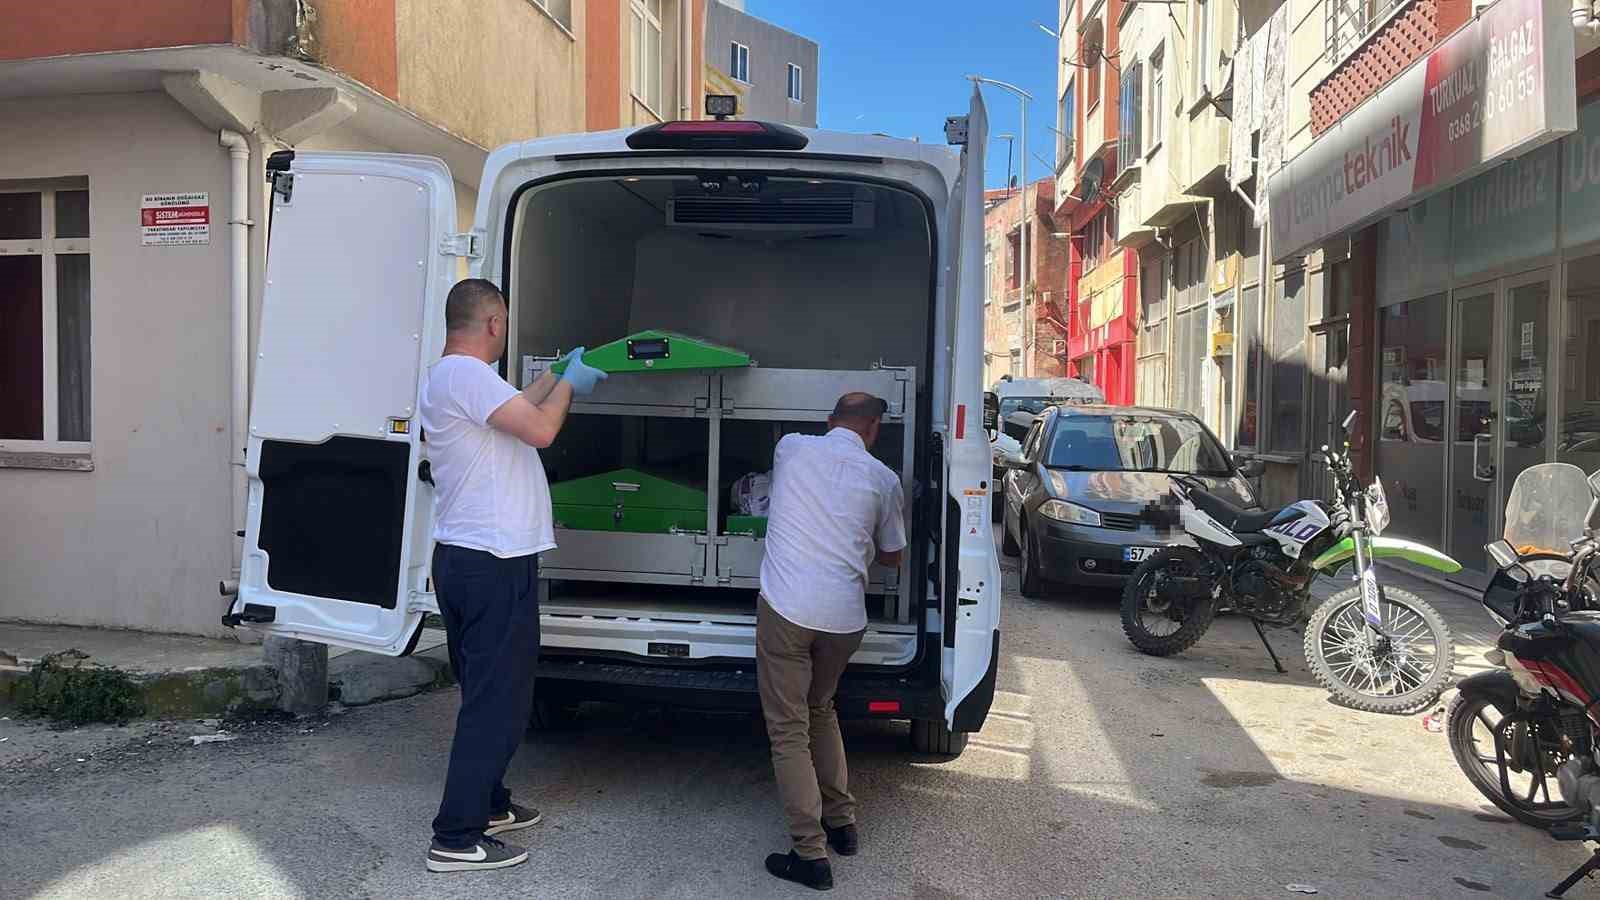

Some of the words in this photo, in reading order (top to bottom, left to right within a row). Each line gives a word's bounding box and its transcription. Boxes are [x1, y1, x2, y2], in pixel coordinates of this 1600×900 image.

[1429, 62, 1475, 117] TURKUAZ
[1448, 112, 1471, 142] 0368
[1497, 79, 1514, 113] 60
[1518, 65, 1536, 101] 55
[1131, 548, 1145, 561] 57
